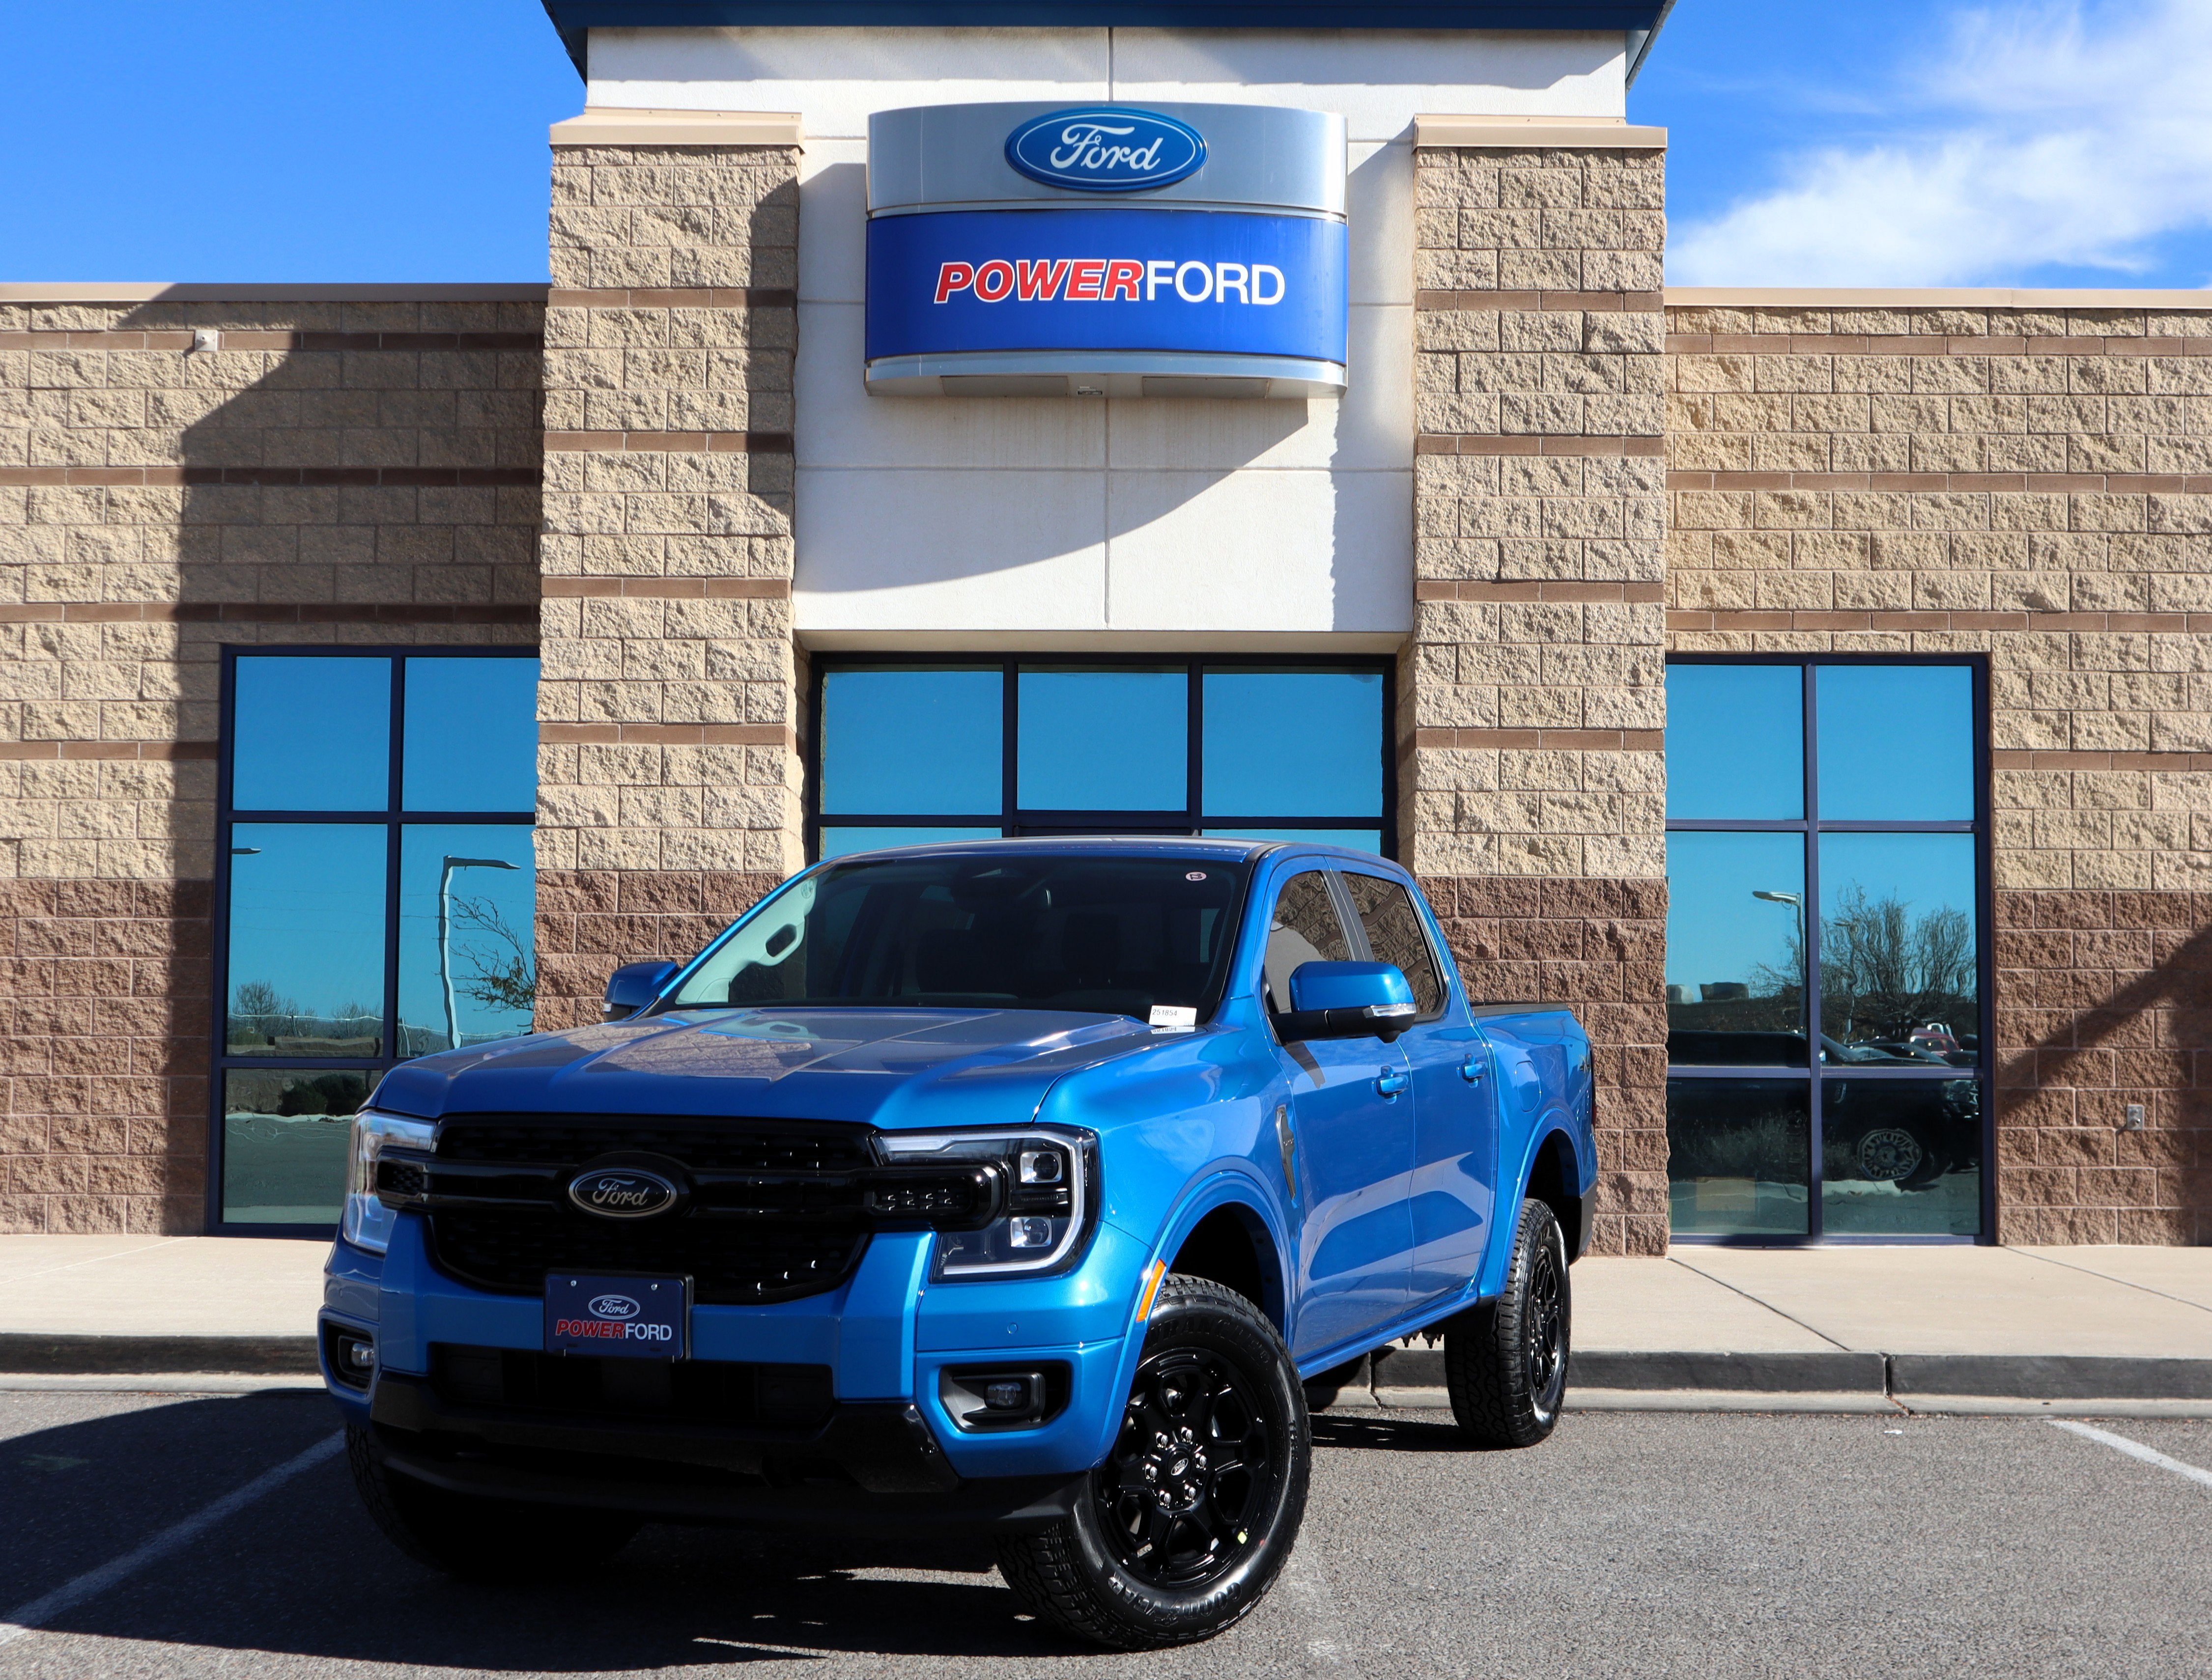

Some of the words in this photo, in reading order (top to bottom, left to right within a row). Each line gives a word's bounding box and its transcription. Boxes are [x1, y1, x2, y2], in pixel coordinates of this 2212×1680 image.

[1050, 124, 1163, 170] Ford
[934, 259, 1285, 305] POWERFORD
[592, 1177, 648, 1205] Ford
[598, 1299, 630, 1315] Ford
[555, 1319, 672, 1341] POWERFORD
